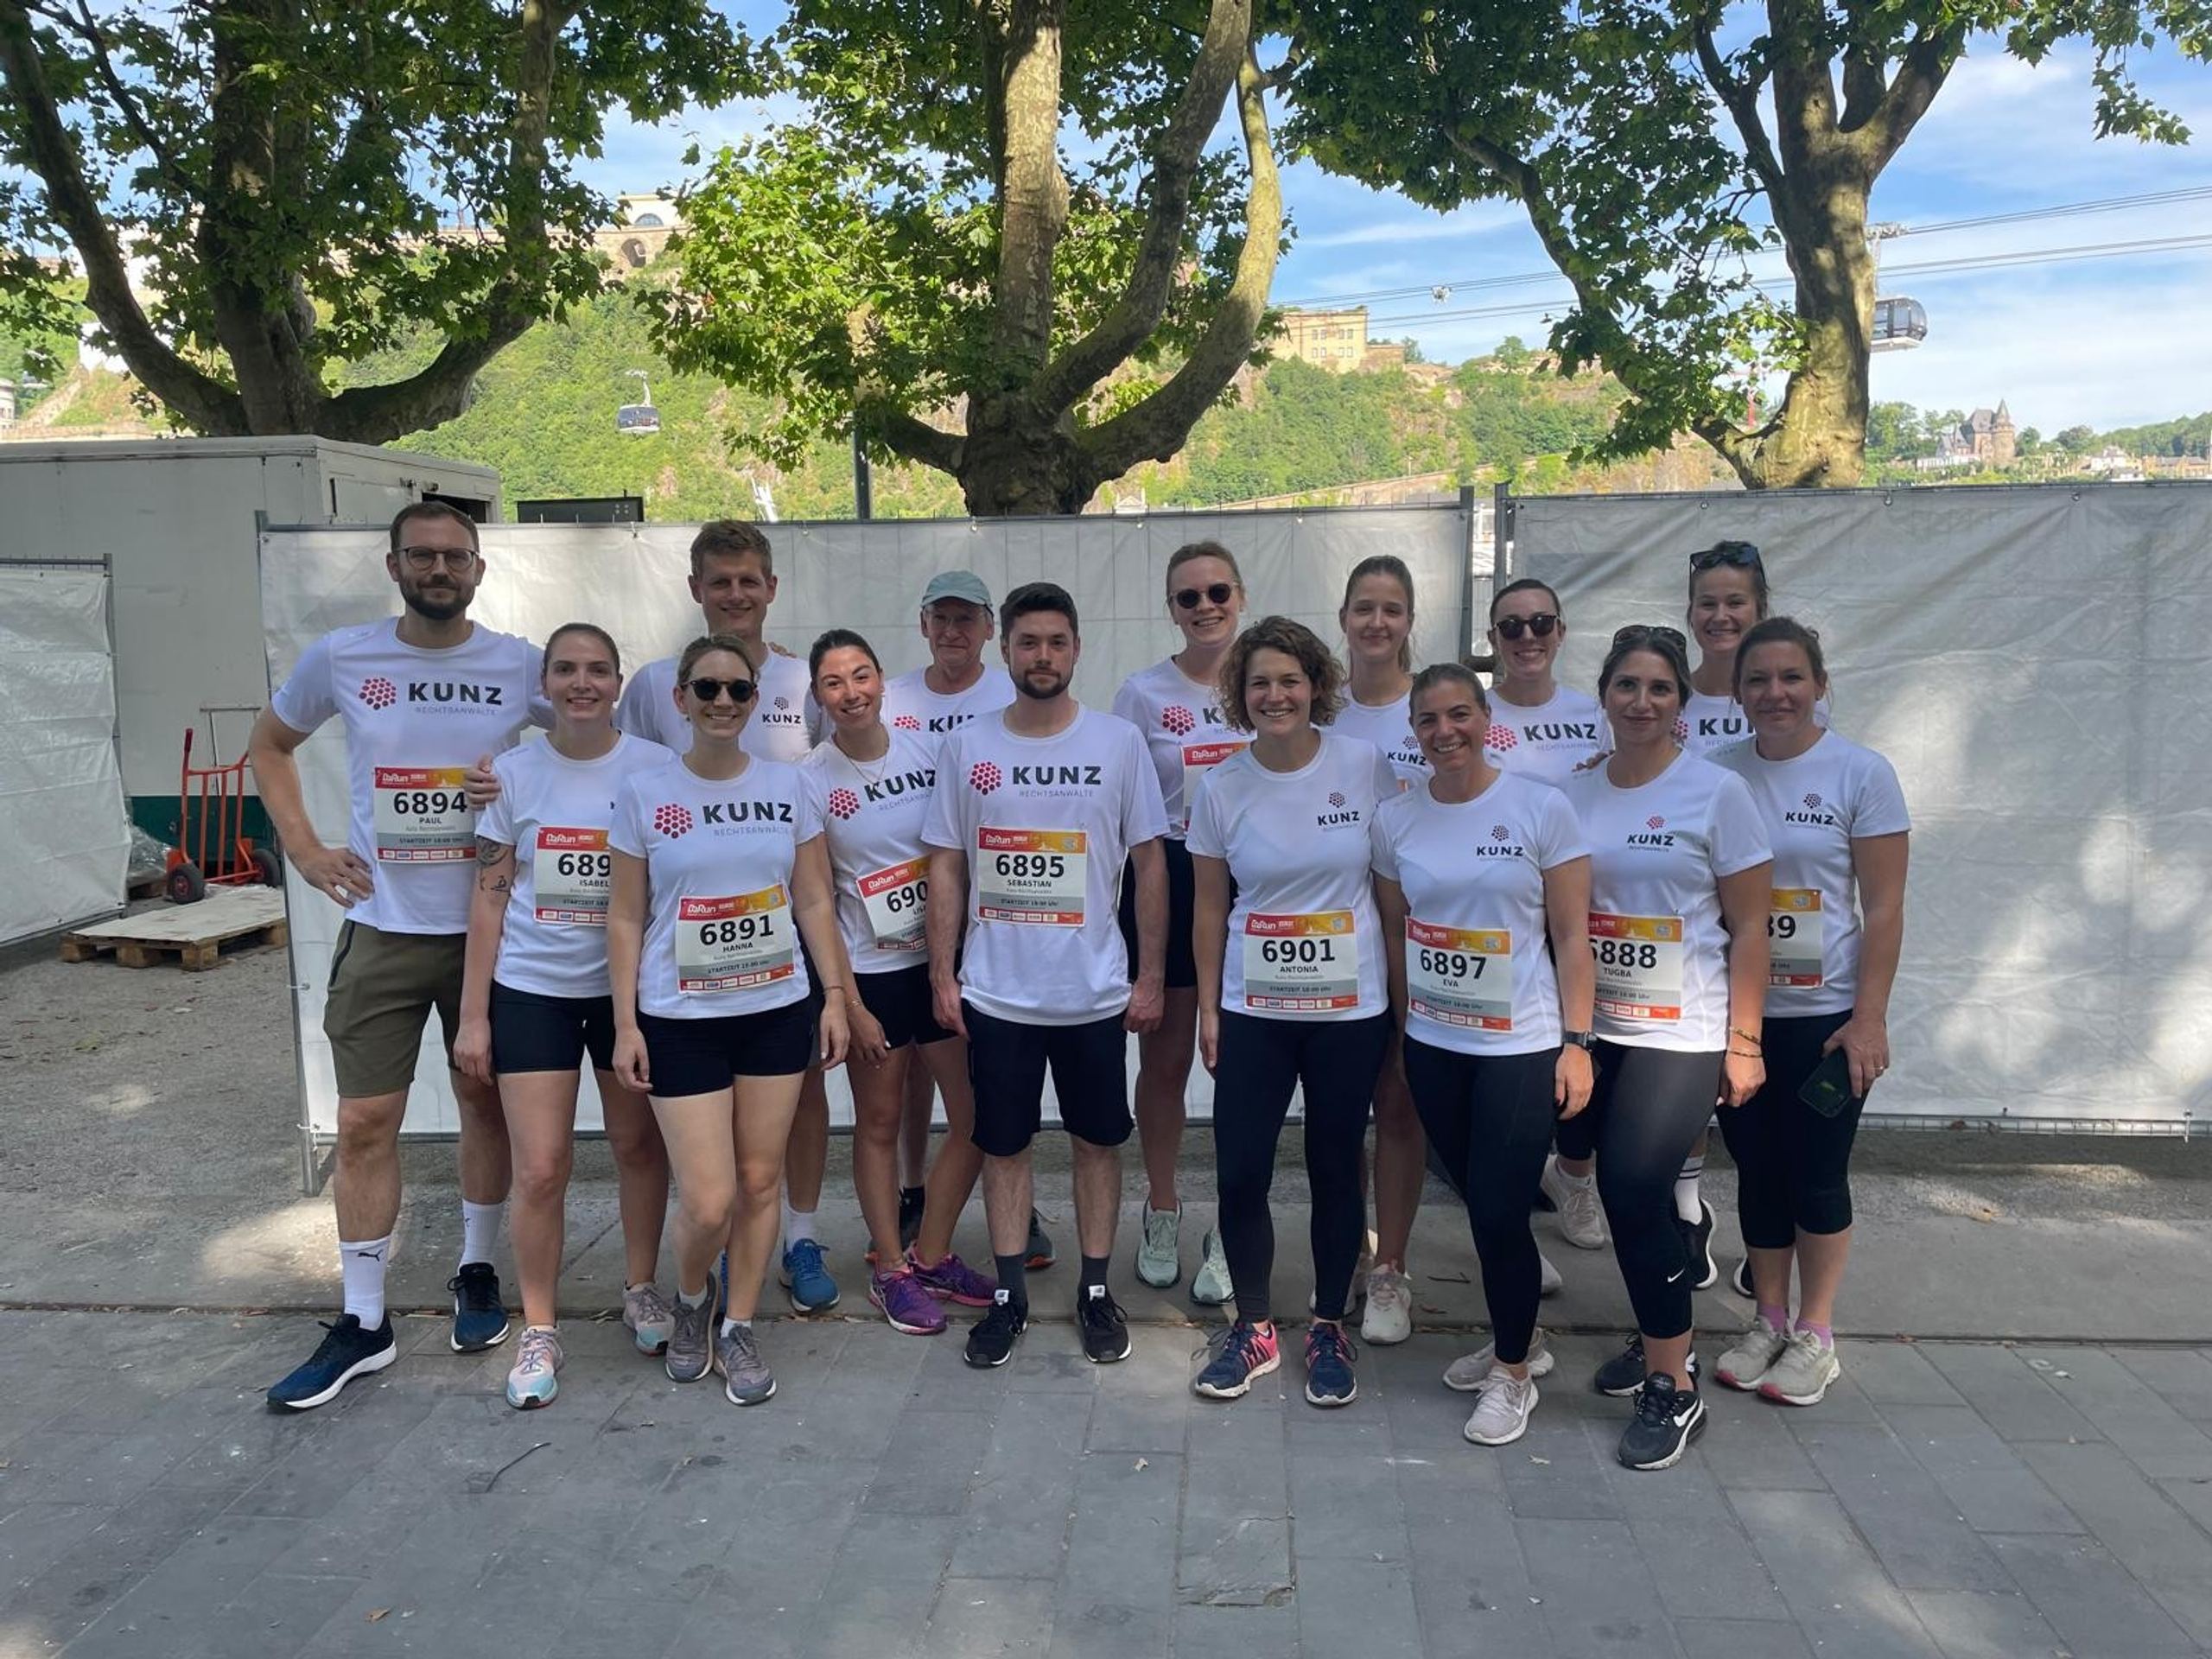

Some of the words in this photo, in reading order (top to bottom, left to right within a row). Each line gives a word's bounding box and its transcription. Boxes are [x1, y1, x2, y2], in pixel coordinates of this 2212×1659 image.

[409, 683, 501, 705] KUNZ
[762, 714, 801, 724] KUNZ
[1523, 723, 1597, 741] KUNZ
[1388, 752, 1427, 766] KUNZ
[1013, 766, 1102, 785] KUNZ
[864, 770, 936, 802] KUNZ
[394, 791, 467, 814] 6894
[702, 802, 793, 824] KUNZ
[1318, 810, 1360, 826] KUNZ
[1785, 811, 1834, 825] KUNZ
[1627, 834, 1675, 846] KUNZ
[1477, 846, 1523, 856] KUNZ
[995, 854, 1065, 878] 6895
[700, 914, 773, 945] 6891
[722, 942, 753, 952] HANNA
[1262, 938, 1336, 963] 6901
[1421, 949, 1487, 980] 6897
[1604, 968, 1631, 977] TUGBA
